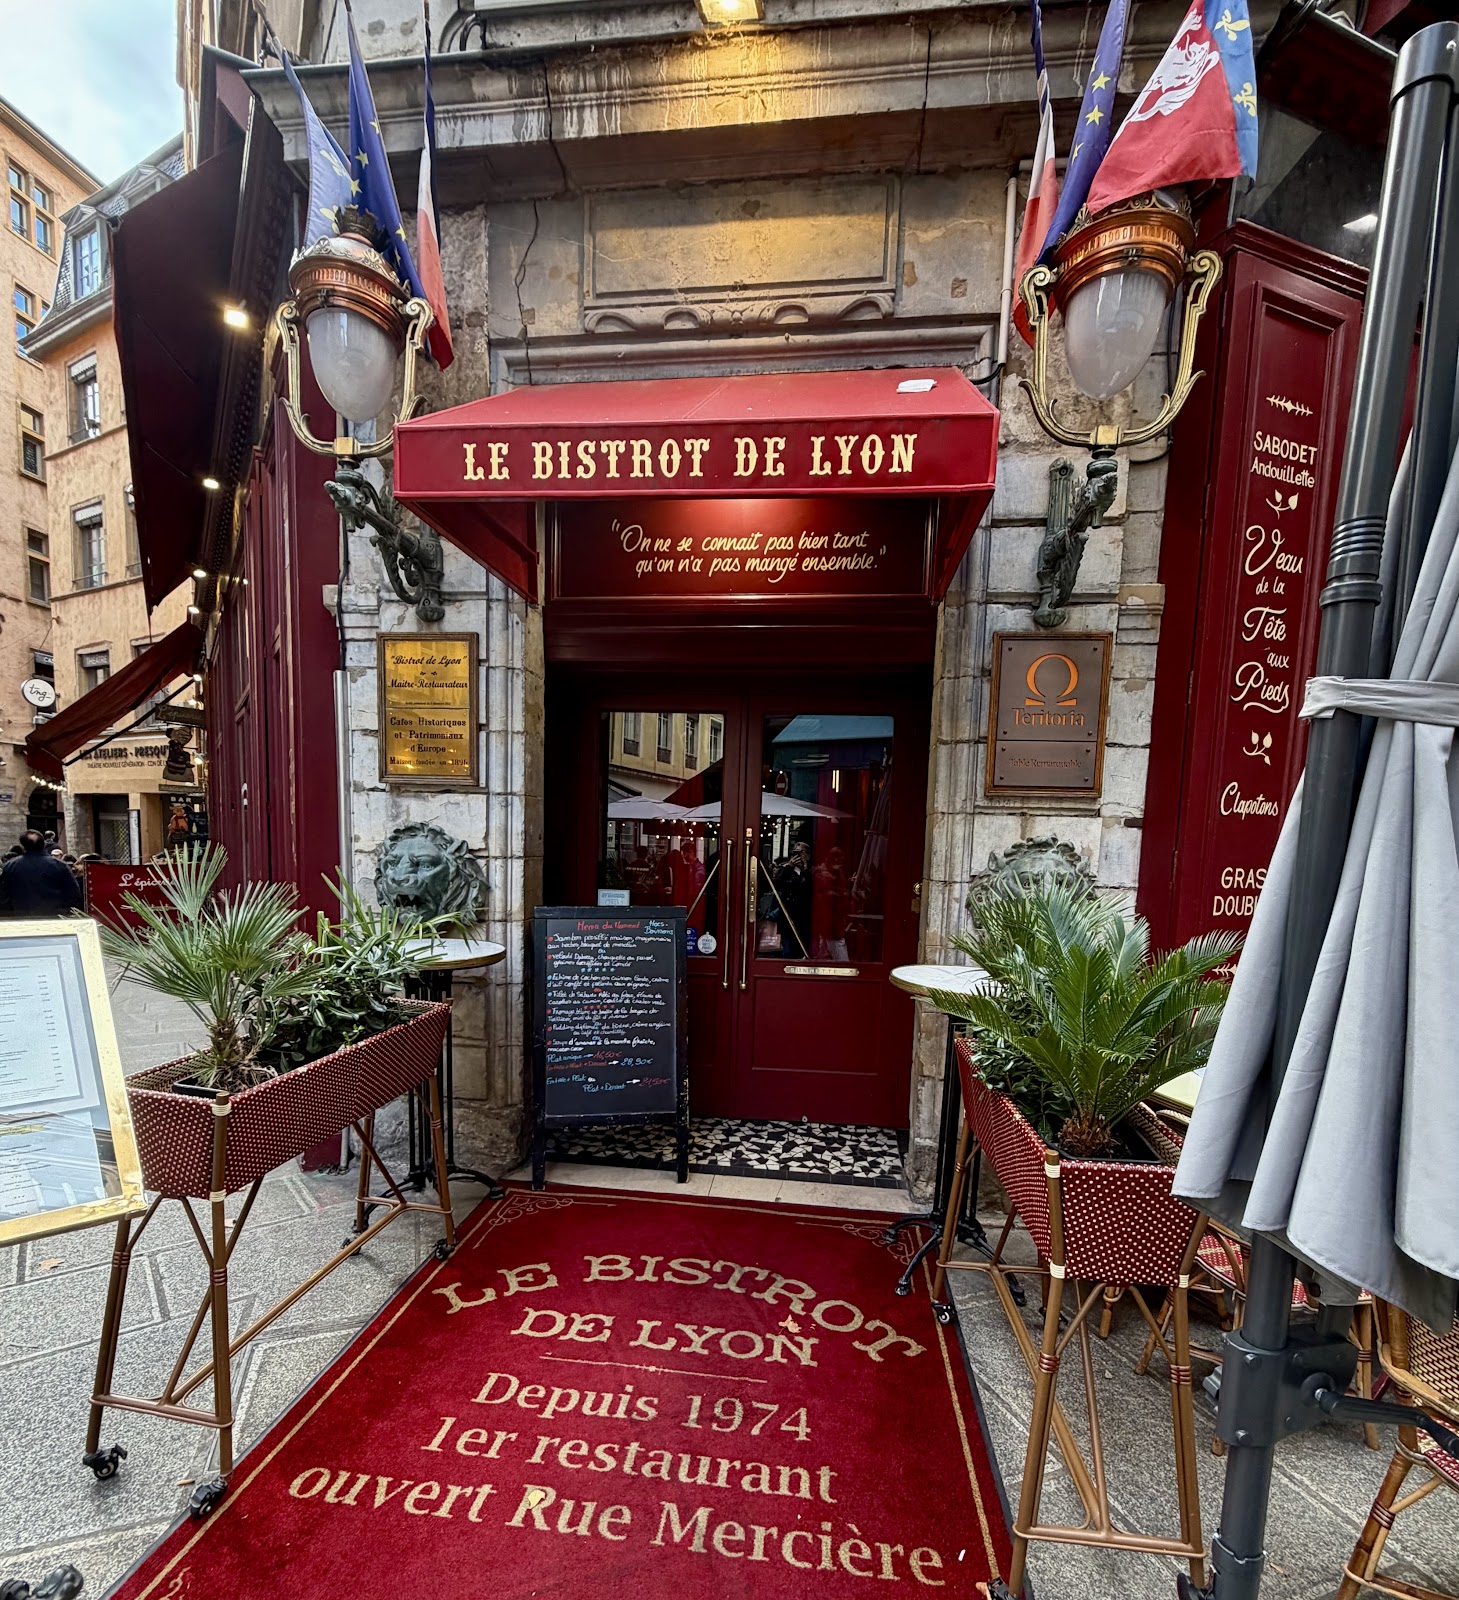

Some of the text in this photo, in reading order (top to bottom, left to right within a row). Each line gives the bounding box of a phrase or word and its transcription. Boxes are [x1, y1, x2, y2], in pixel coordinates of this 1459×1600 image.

[463, 433, 918, 480] LE BISTROT DE LYON
[1253, 430, 1318, 465] SABODET
[1250, 456, 1315, 488] Andouillette
[653, 537, 671, 552] ne
[677, 535, 692, 552] se
[701, 531, 763, 551] connait
[764, 533, 794, 555] pas
[798, 530, 828, 550] bien
[832, 531, 870, 548] tant
[1245, 525, 1304, 575] Veau
[635, 557, 674, 578] qu'on
[678, 555, 702, 572] n'a
[708, 557, 741, 577] pas
[744, 552, 800, 583] mangé
[1255, 576, 1285, 595] de la
[1242, 606, 1287, 641] Tête
[426, 655, 437, 665] de
[1266, 652, 1290, 669] aux
[1230, 661, 1290, 713] Pieds
[418, 717, 466, 728] Historiques
[1011, 707, 1085, 726] Teritoria
[409, 730, 464, 739] Patrimoniaux
[1220, 781, 1278, 820] Clapotons
[1221, 867, 1267, 889] GRAS
[431, 1254, 928, 1363] LE BISTROT
[510, 1307, 820, 1368] DE LYON
[471, 1371, 812, 1441] Depuis 1974
[419, 1415, 838, 1504] 1er restaurant
[287, 1465, 946, 1588] ouvert Rue Mercière
